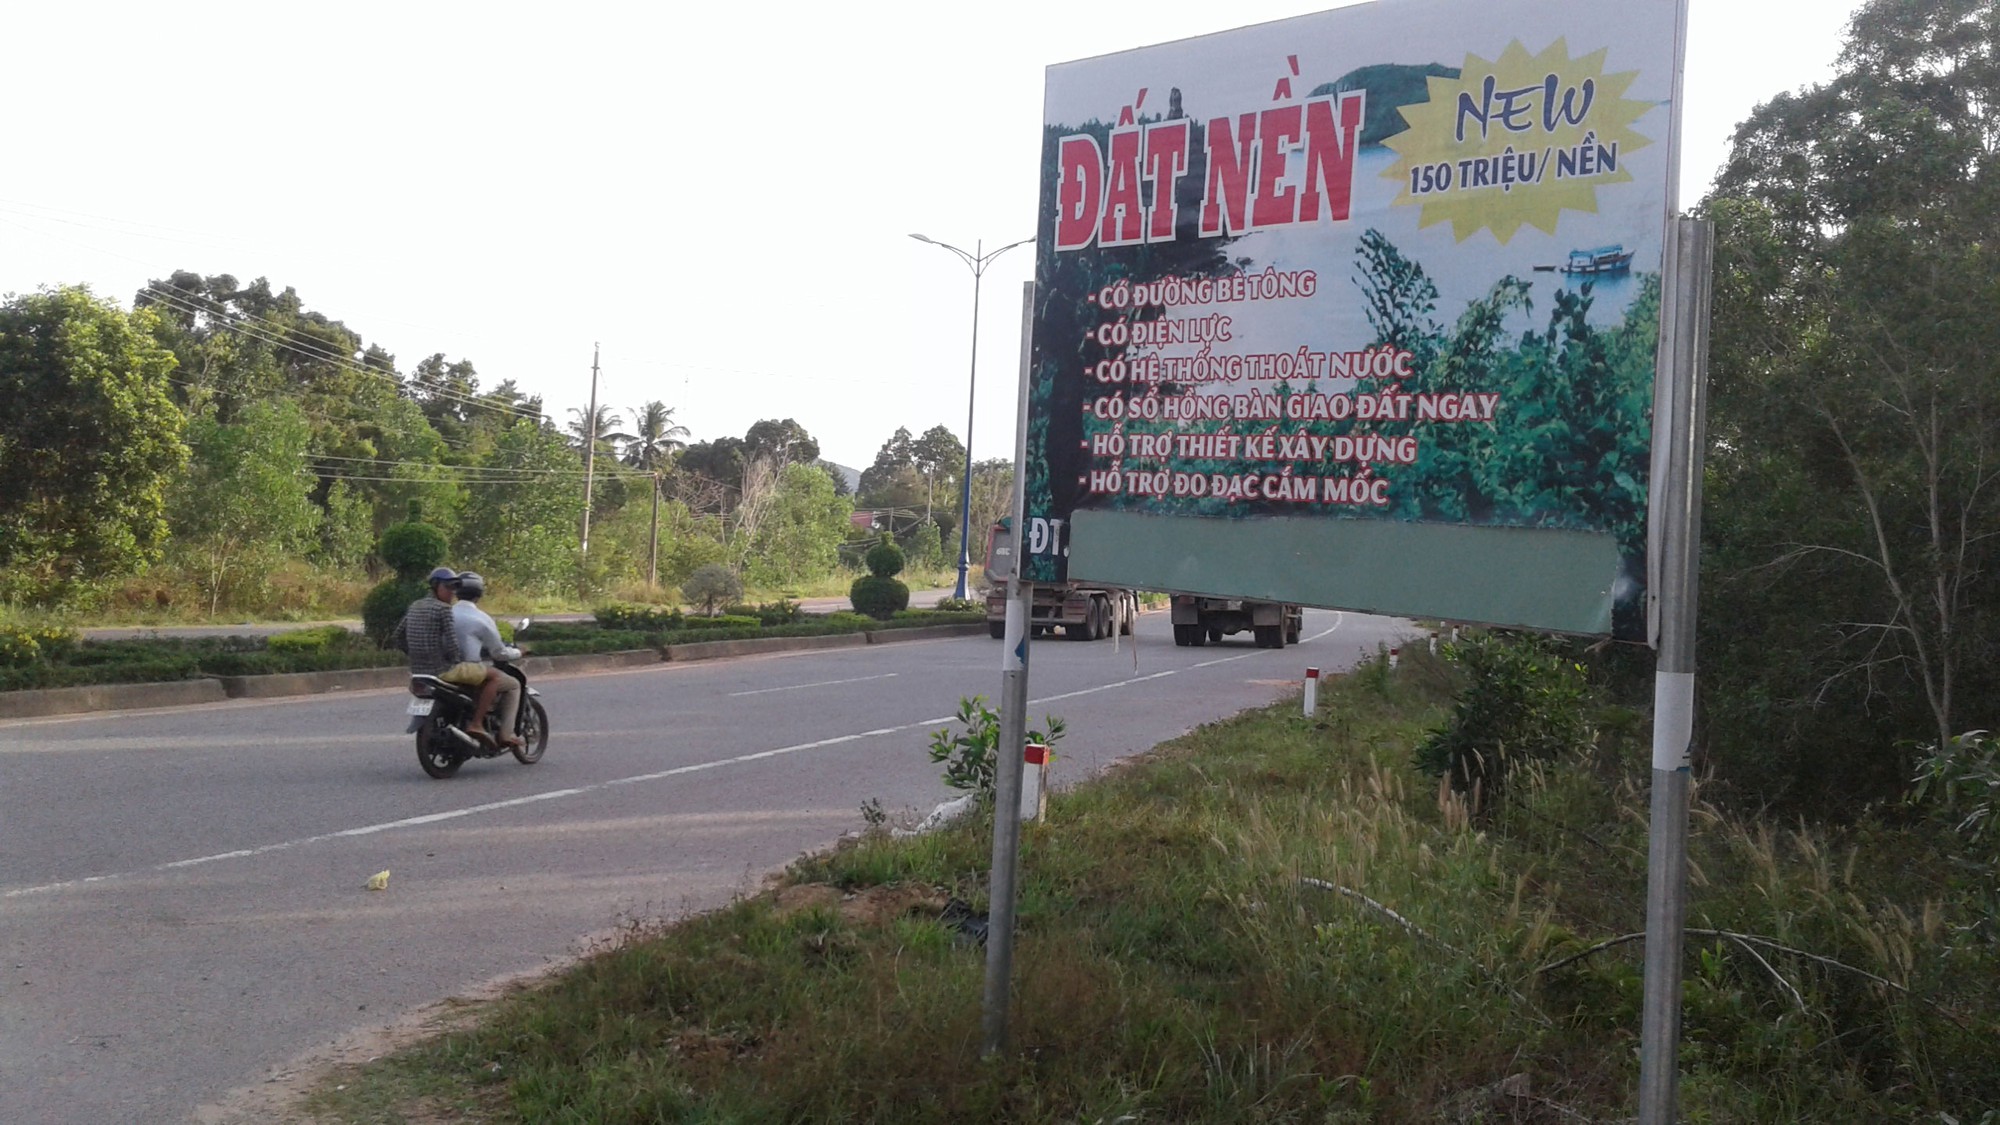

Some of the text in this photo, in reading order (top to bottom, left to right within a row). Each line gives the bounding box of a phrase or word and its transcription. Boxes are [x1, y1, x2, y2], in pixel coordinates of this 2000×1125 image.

[1455, 73, 1595, 142] NEW
[1054, 55, 1366, 251] ĐẤT NỀN
[1410, 162, 1452, 194] 150
[1099, 279, 1129, 308] CÓ
[1133, 275, 1213, 306] ĐƯỜNG
[1216, 270, 1246, 302] BÊ
[1249, 266, 1316, 299] TÔNG
[1098, 315, 1128, 345] CÓ
[1132, 313, 1184, 349] ĐIỆN
[1188, 313, 1232, 347] LỰC
[1096, 352, 1126, 382] CÓ
[1130, 352, 1160, 386] HỆ
[1164, 347, 1243, 382] THỐNG
[1245, 346, 1326, 380] THOÁT
[1330, 342, 1415, 379] NƯỚC
[1094, 390, 1124, 418] CÓ
[1128, 386, 1159, 419] SỔ
[1163, 386, 1231, 420] HỒNG
[1234, 388, 1282, 420] BÀN
[1286, 393, 1351, 421] GIAO
[1355, 383, 1412, 422] ĐẤT
[1417, 392, 1499, 422] NGAY
[1092, 422, 1125, 457] HỖ
[1128, 429, 1173, 463] TRỢ
[1176, 427, 1242, 458] THIẾT
[1244, 425, 1276, 459] KẾ
[1277, 427, 1333, 461] XÂY
[1334, 432, 1418, 467] DỰNG
[1090, 460, 1122, 492] HỖ
[1125, 468, 1170, 502] TRỢ
[1173, 473, 1208, 496] ĐO
[1211, 474, 1259, 503] ĐẠC
[1262, 464, 1317, 501] CẮM
[1322, 468, 1390, 505] MỐC
